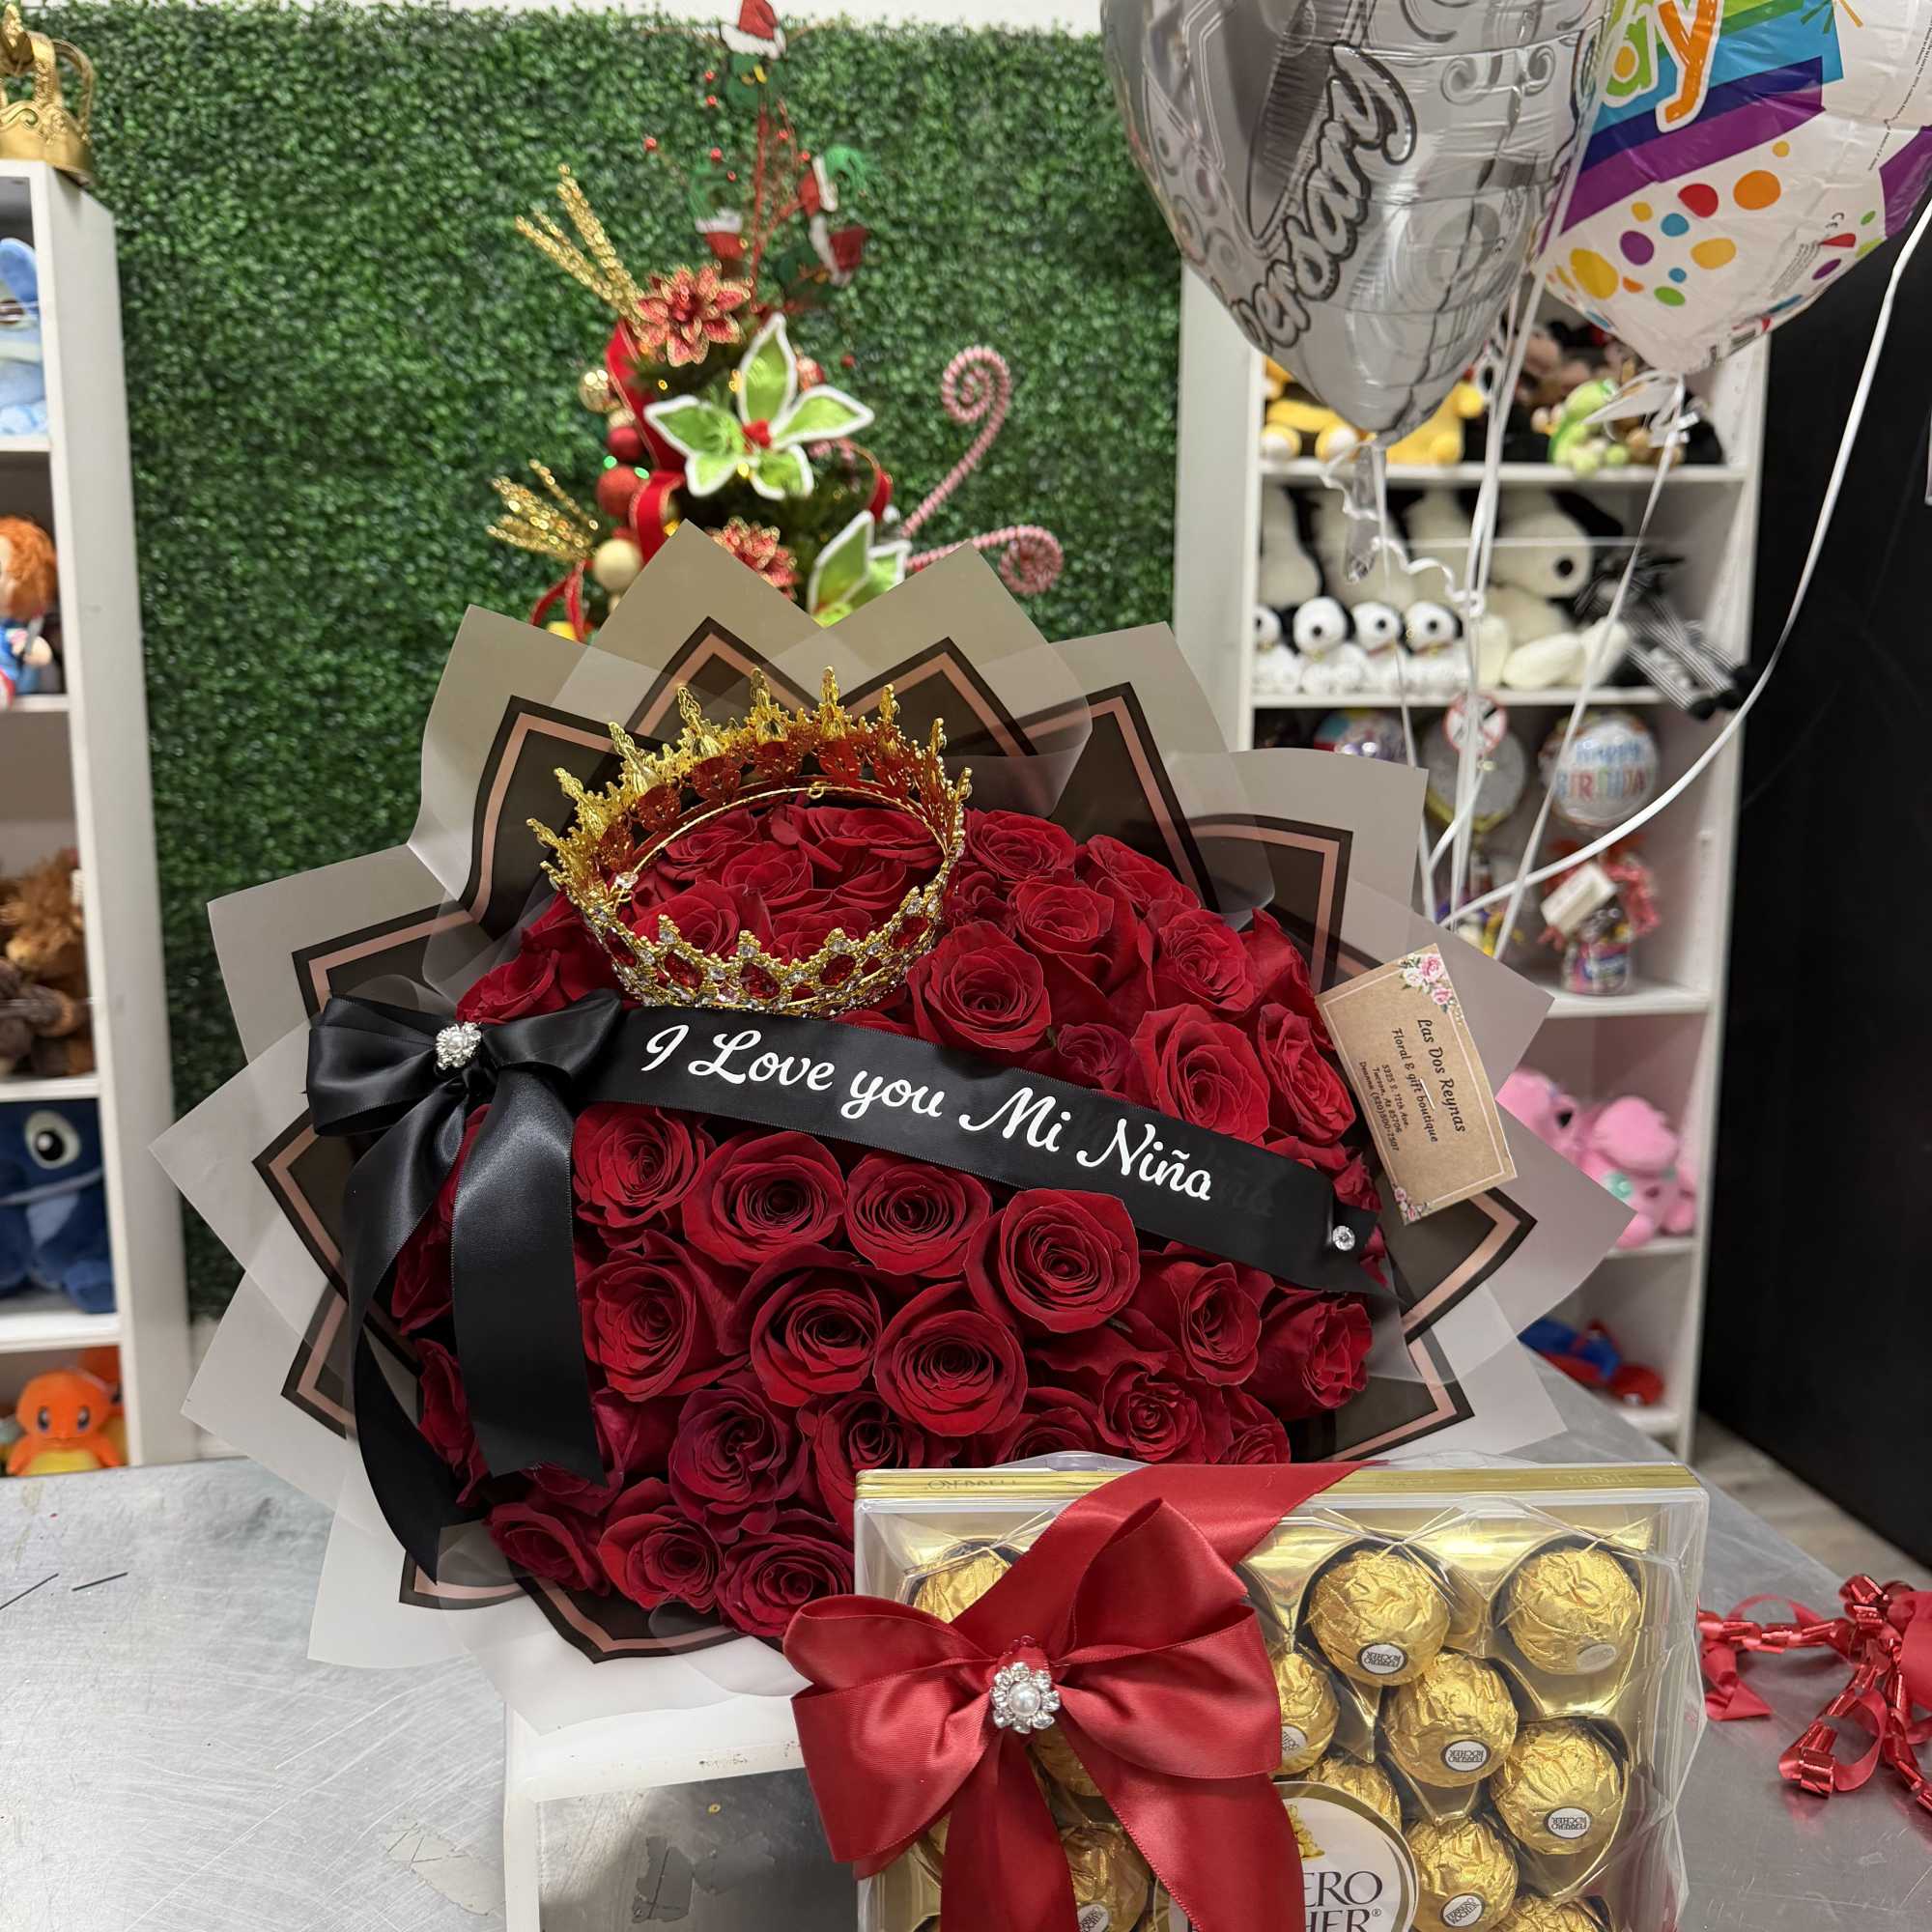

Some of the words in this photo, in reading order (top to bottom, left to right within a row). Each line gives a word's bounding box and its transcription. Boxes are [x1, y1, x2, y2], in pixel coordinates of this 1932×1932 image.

[642, 1025, 690, 1072] I
[688, 1029, 835, 1091] Love
[840, 1070, 945, 1119] you
[958, 1087, 1071, 1151] Mi
[1076, 1119, 1211, 1201] Niña
[1392, 1028, 1412, 1060] Floral
[1406, 1073, 1423, 1093] gift
[1416, 1095, 1438, 1142] boutique
[1417, 1019, 1435, 1042] Las
[1428, 1046, 1445, 1073] Dos
[1439, 1078, 1465, 1132] Reynas
